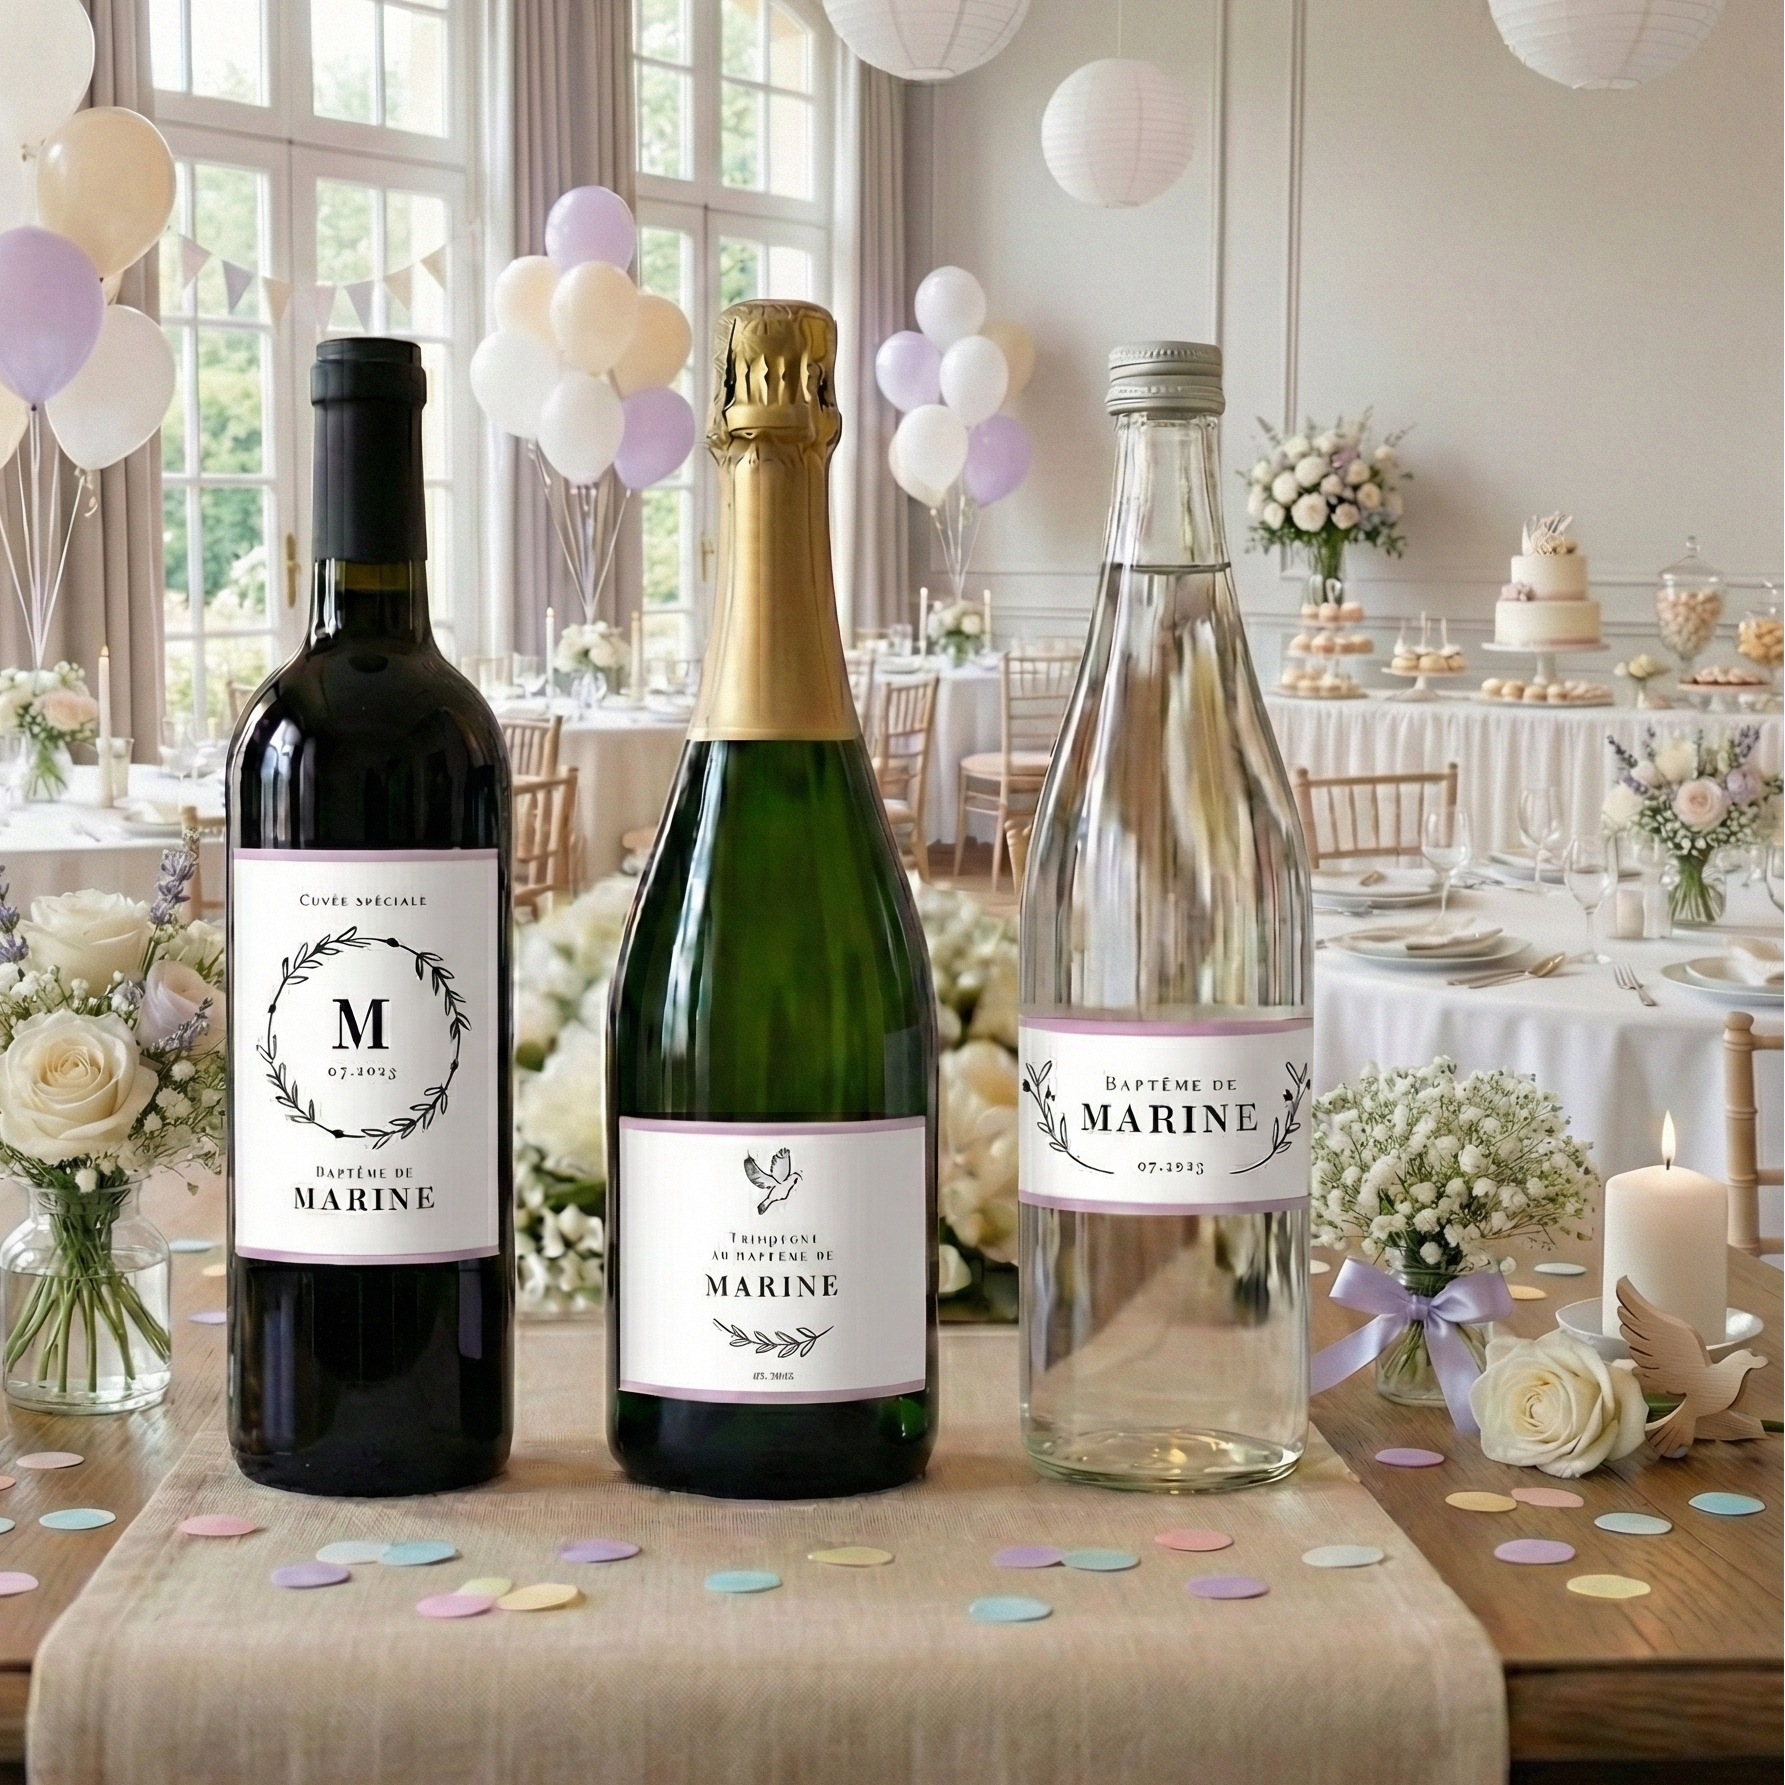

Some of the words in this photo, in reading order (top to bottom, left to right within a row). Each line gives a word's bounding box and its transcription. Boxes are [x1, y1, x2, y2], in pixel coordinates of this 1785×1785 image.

[331, 998, 390, 1050] M
[1212, 1079, 1237, 1092] DE
[1081, 1102, 1258, 1134] MARINE
[395, 1167, 413, 1179] DE
[294, 1186, 435, 1212] MARINE
[705, 1273, 839, 1298] MARINE
